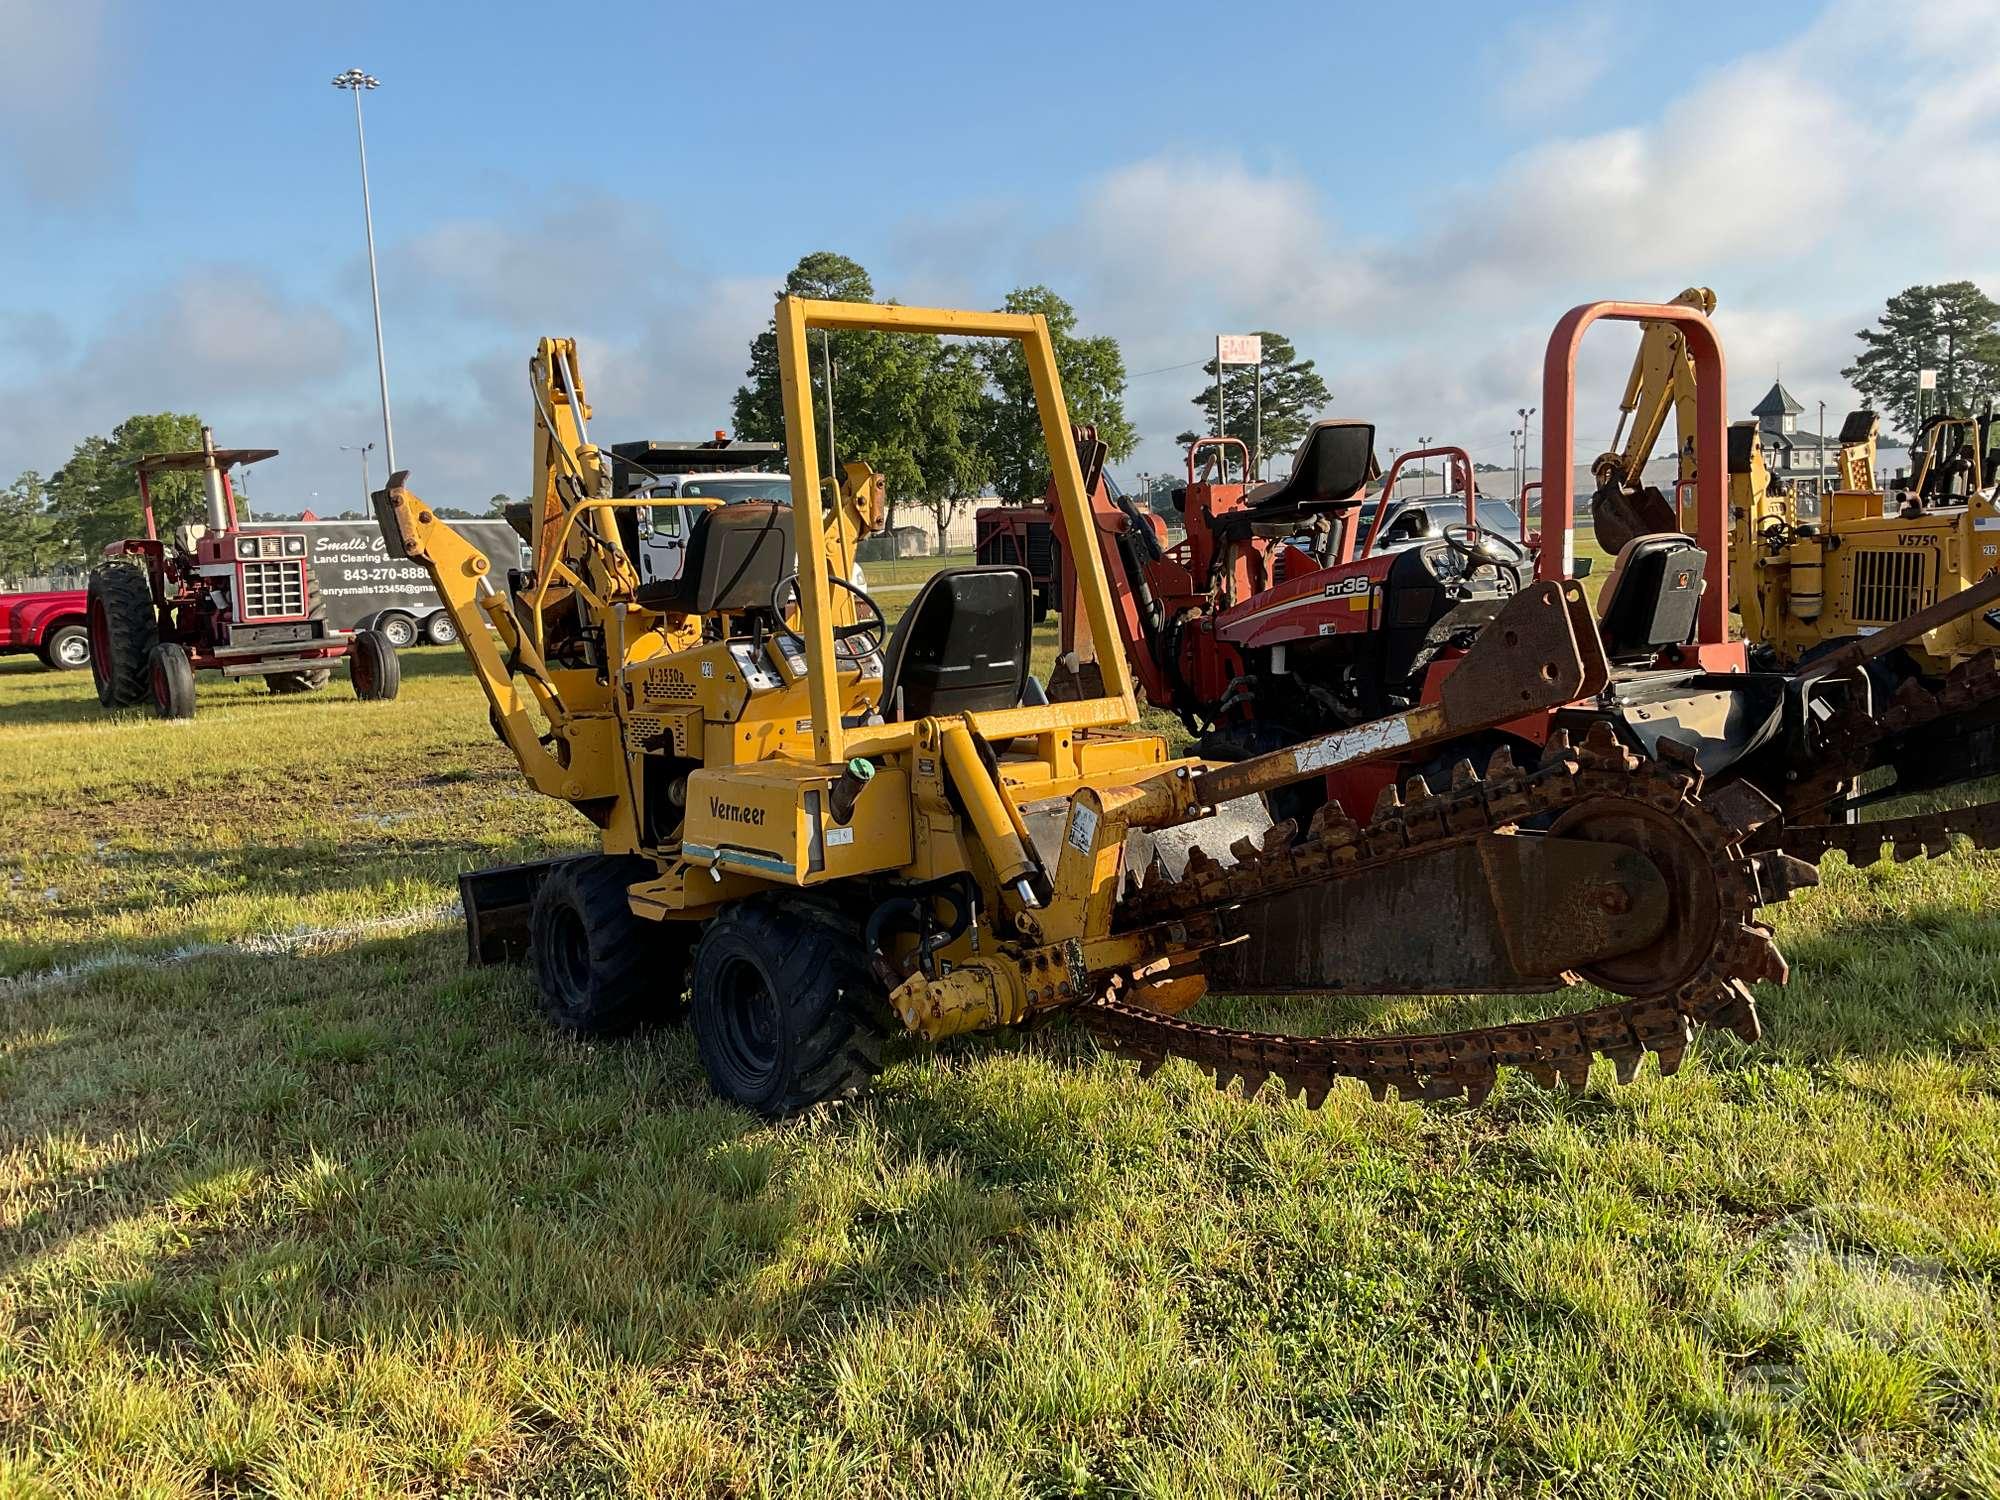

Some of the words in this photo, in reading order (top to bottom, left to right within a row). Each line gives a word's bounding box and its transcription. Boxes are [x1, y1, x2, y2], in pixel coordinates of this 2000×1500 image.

[315, 536, 370, 551] Smalls'
[313, 554, 339, 564] Land
[341, 553, 381, 564] Clearing
[383, 553, 390, 562] &
[1326, 576, 1369, 596] RT36
[710, 796, 766, 826] Vermeer
